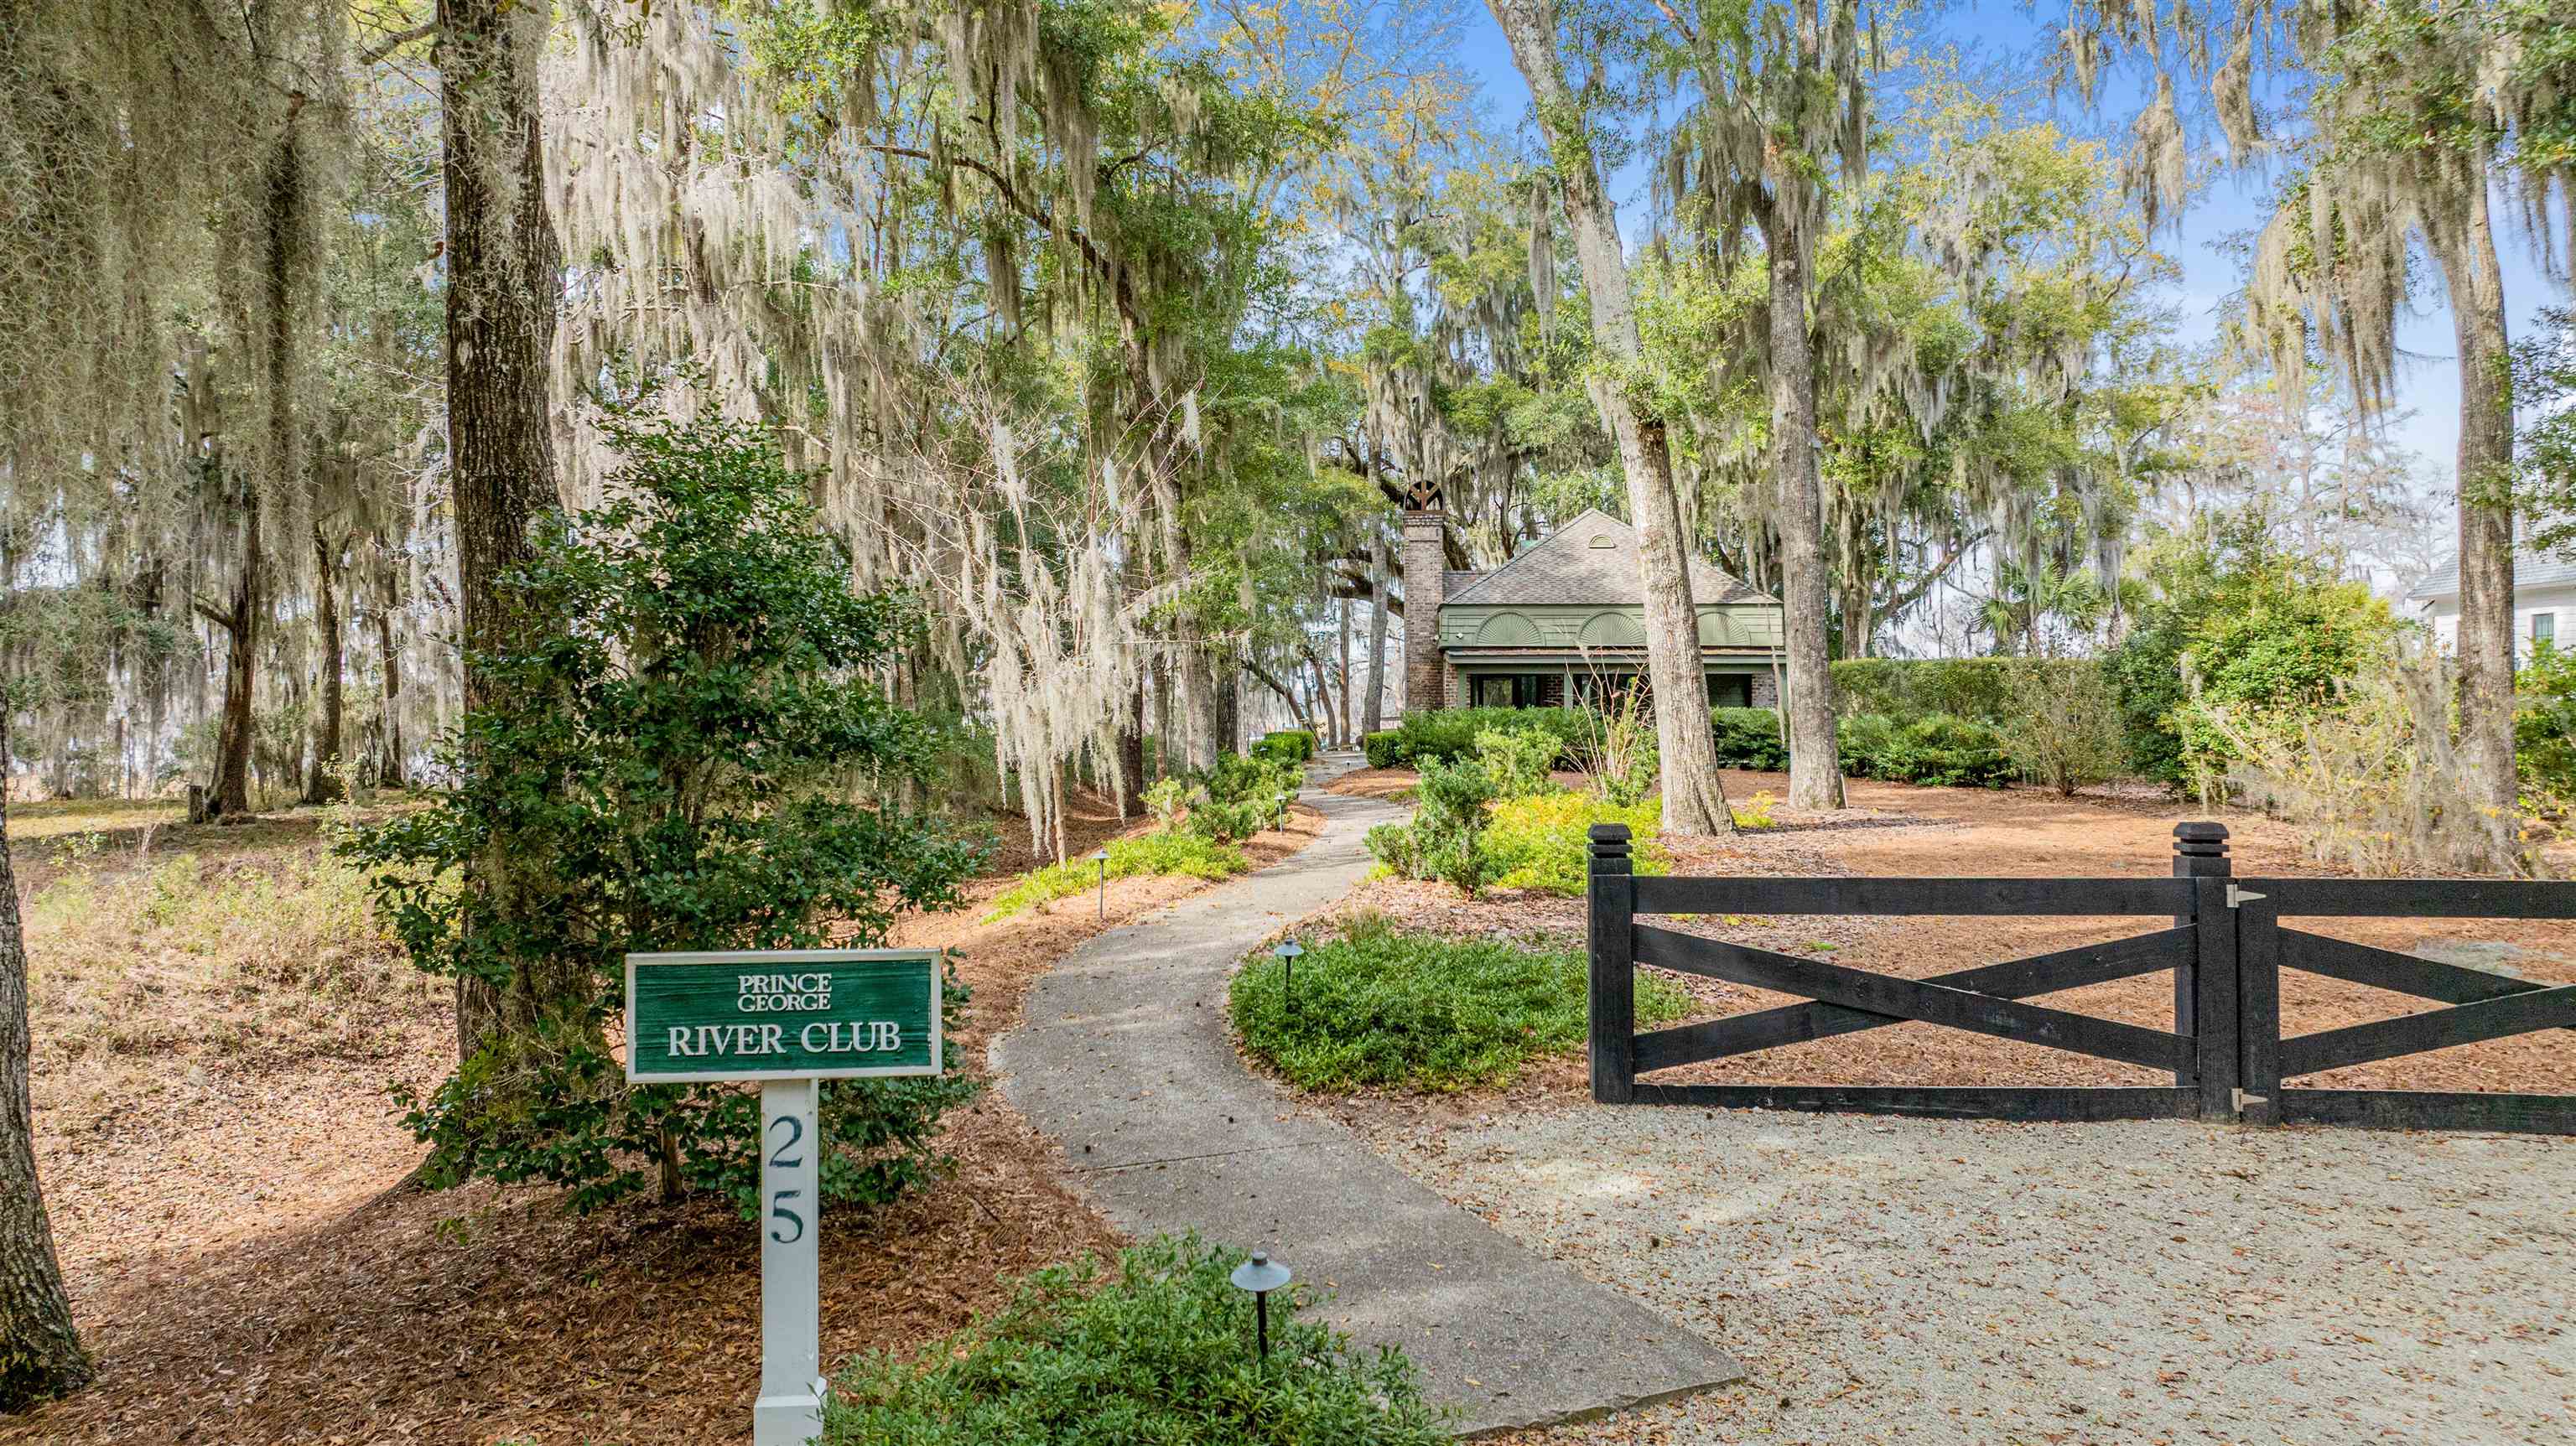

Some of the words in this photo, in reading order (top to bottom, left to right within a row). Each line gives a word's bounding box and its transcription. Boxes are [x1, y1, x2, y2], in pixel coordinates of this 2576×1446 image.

[737, 973, 833, 994] PRINCE
[737, 994, 831, 1013] GEORGE
[667, 1024, 787, 1057] RIVER
[800, 1022, 901, 1053] CLUB
